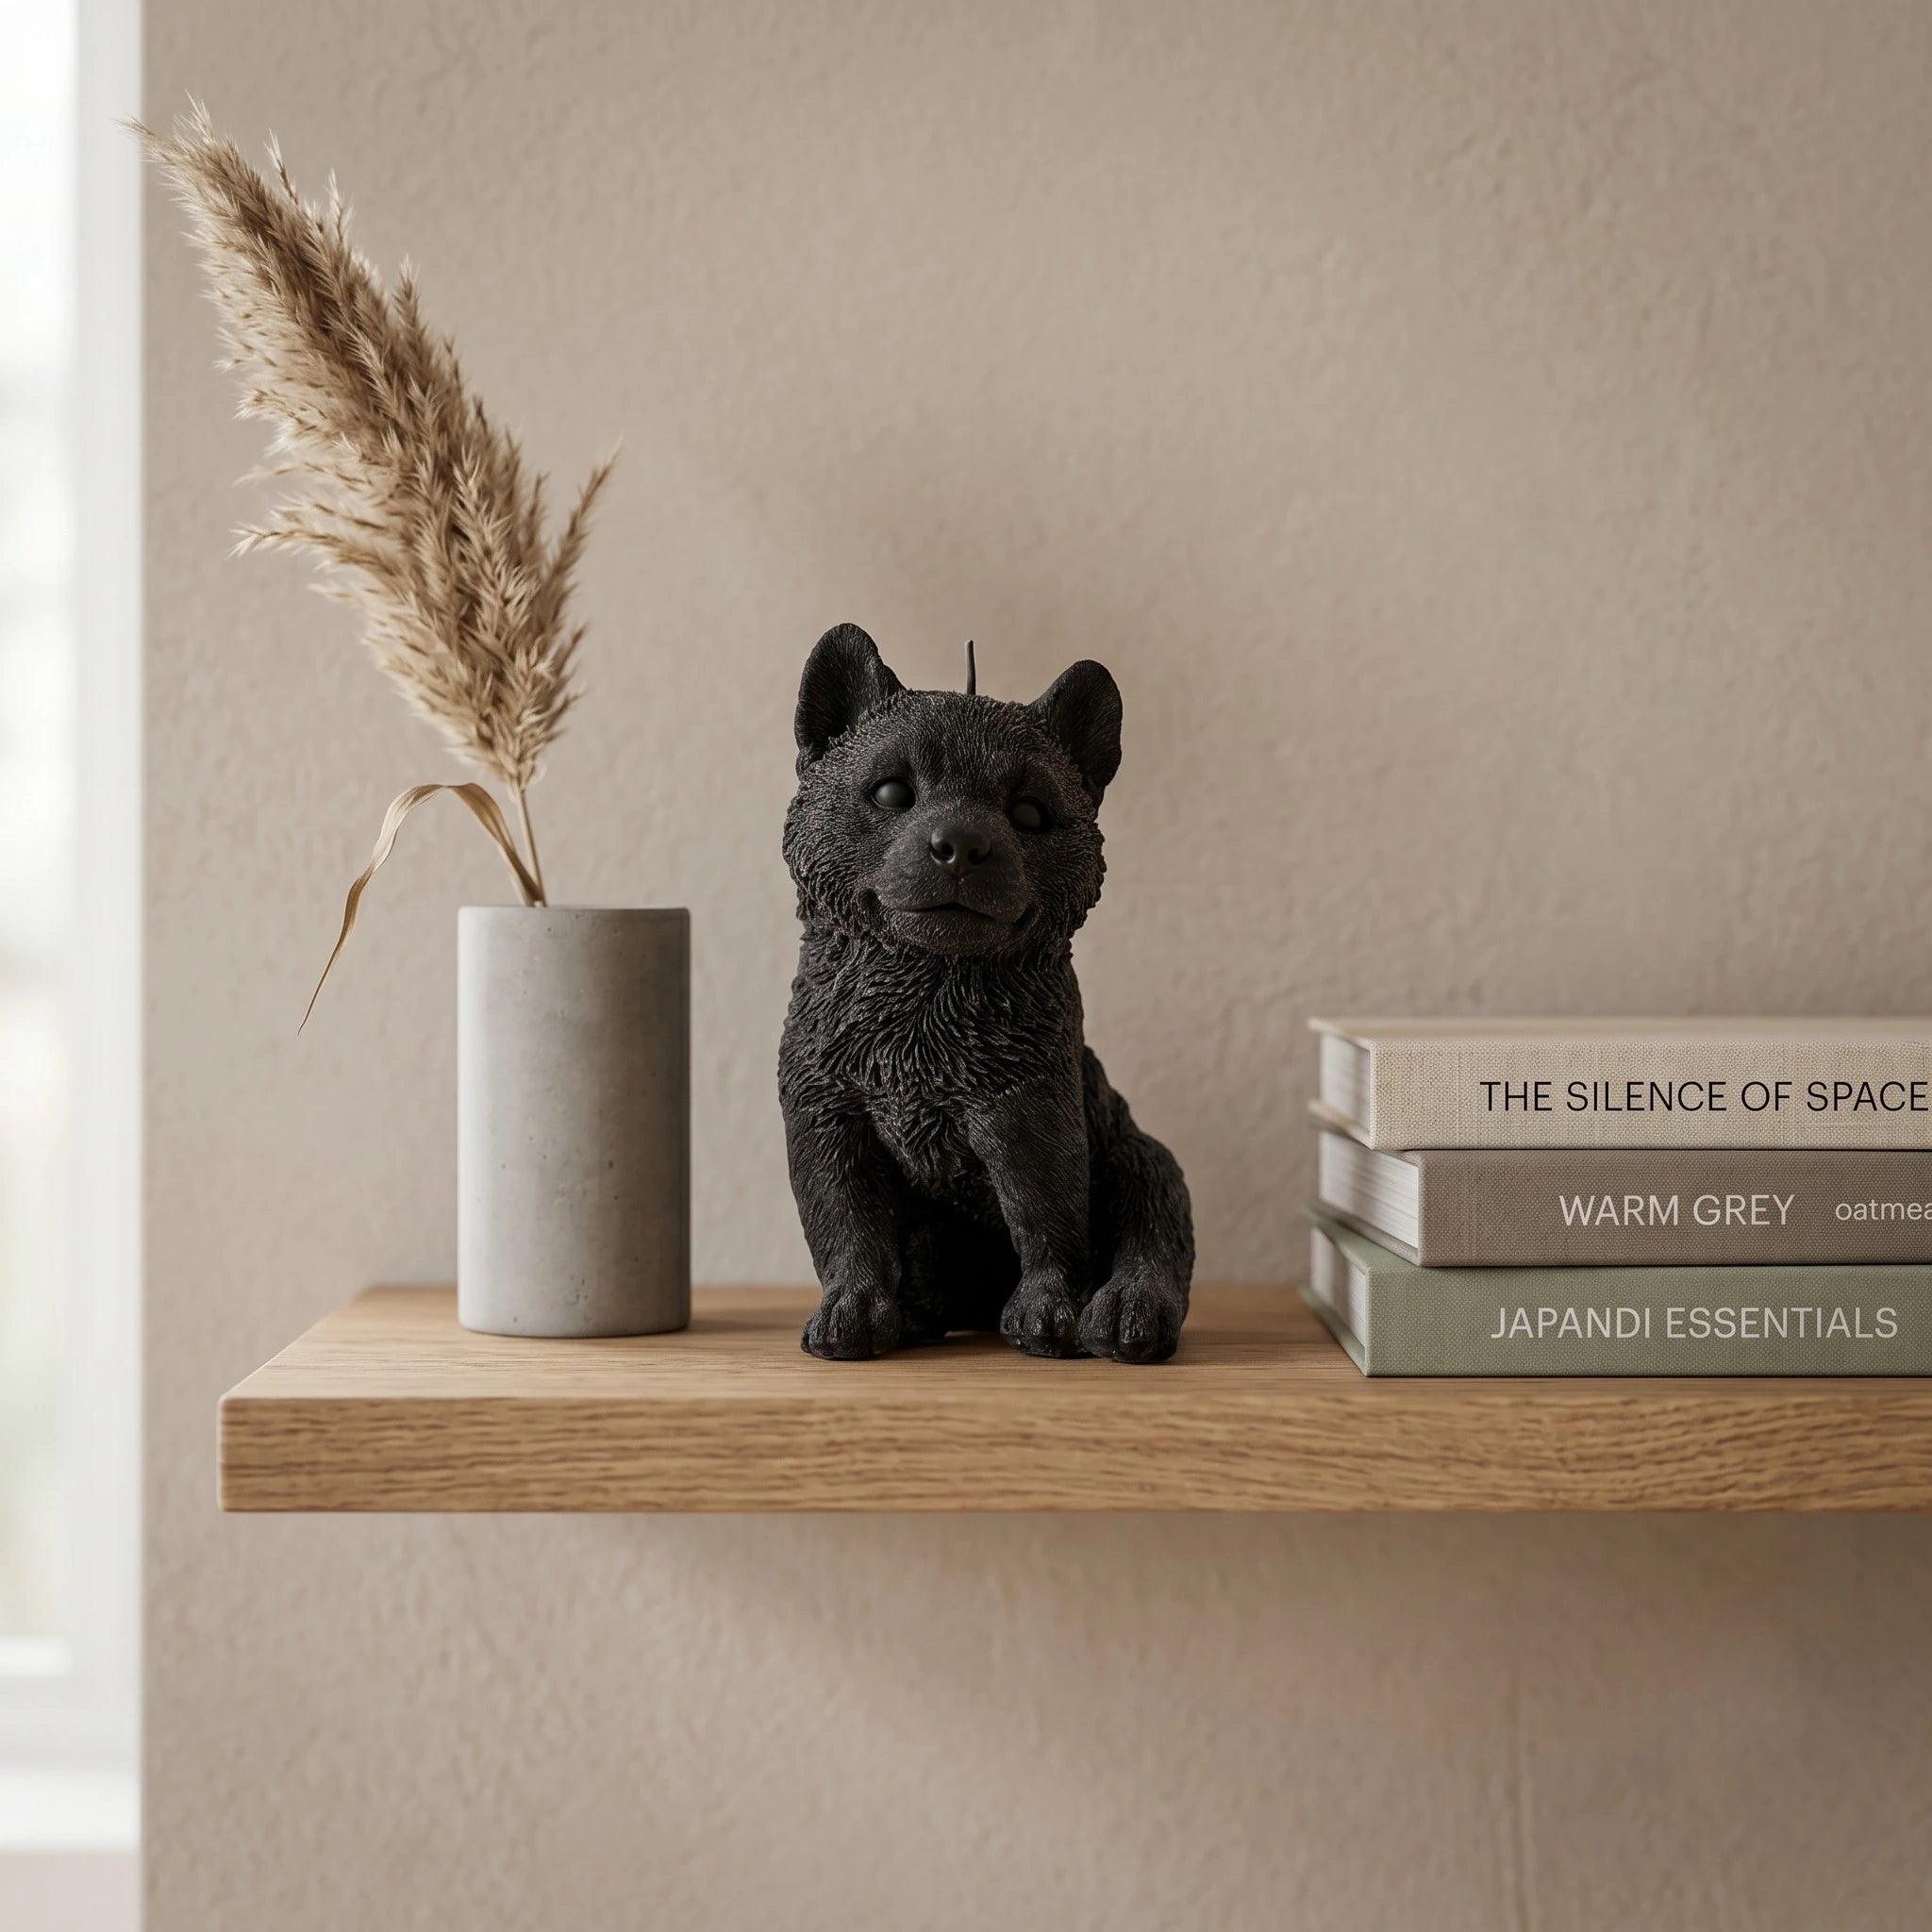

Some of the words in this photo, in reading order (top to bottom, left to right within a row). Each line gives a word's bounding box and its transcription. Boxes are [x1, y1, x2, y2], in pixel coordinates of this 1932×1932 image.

[1480, 1081, 1552, 1111] THE
[1566, 1080, 1726, 1112] SILENCE
[1741, 1080, 1792, 1112] OF
[1807, 1080, 1929, 1112] SPACE
[1559, 1194, 1679, 1225] WARM
[1692, 1193, 1795, 1225] GREY
[1491, 1307, 1651, 1339] JAPANDI
[1666, 1307, 1898, 1339] ESSENTIALS
